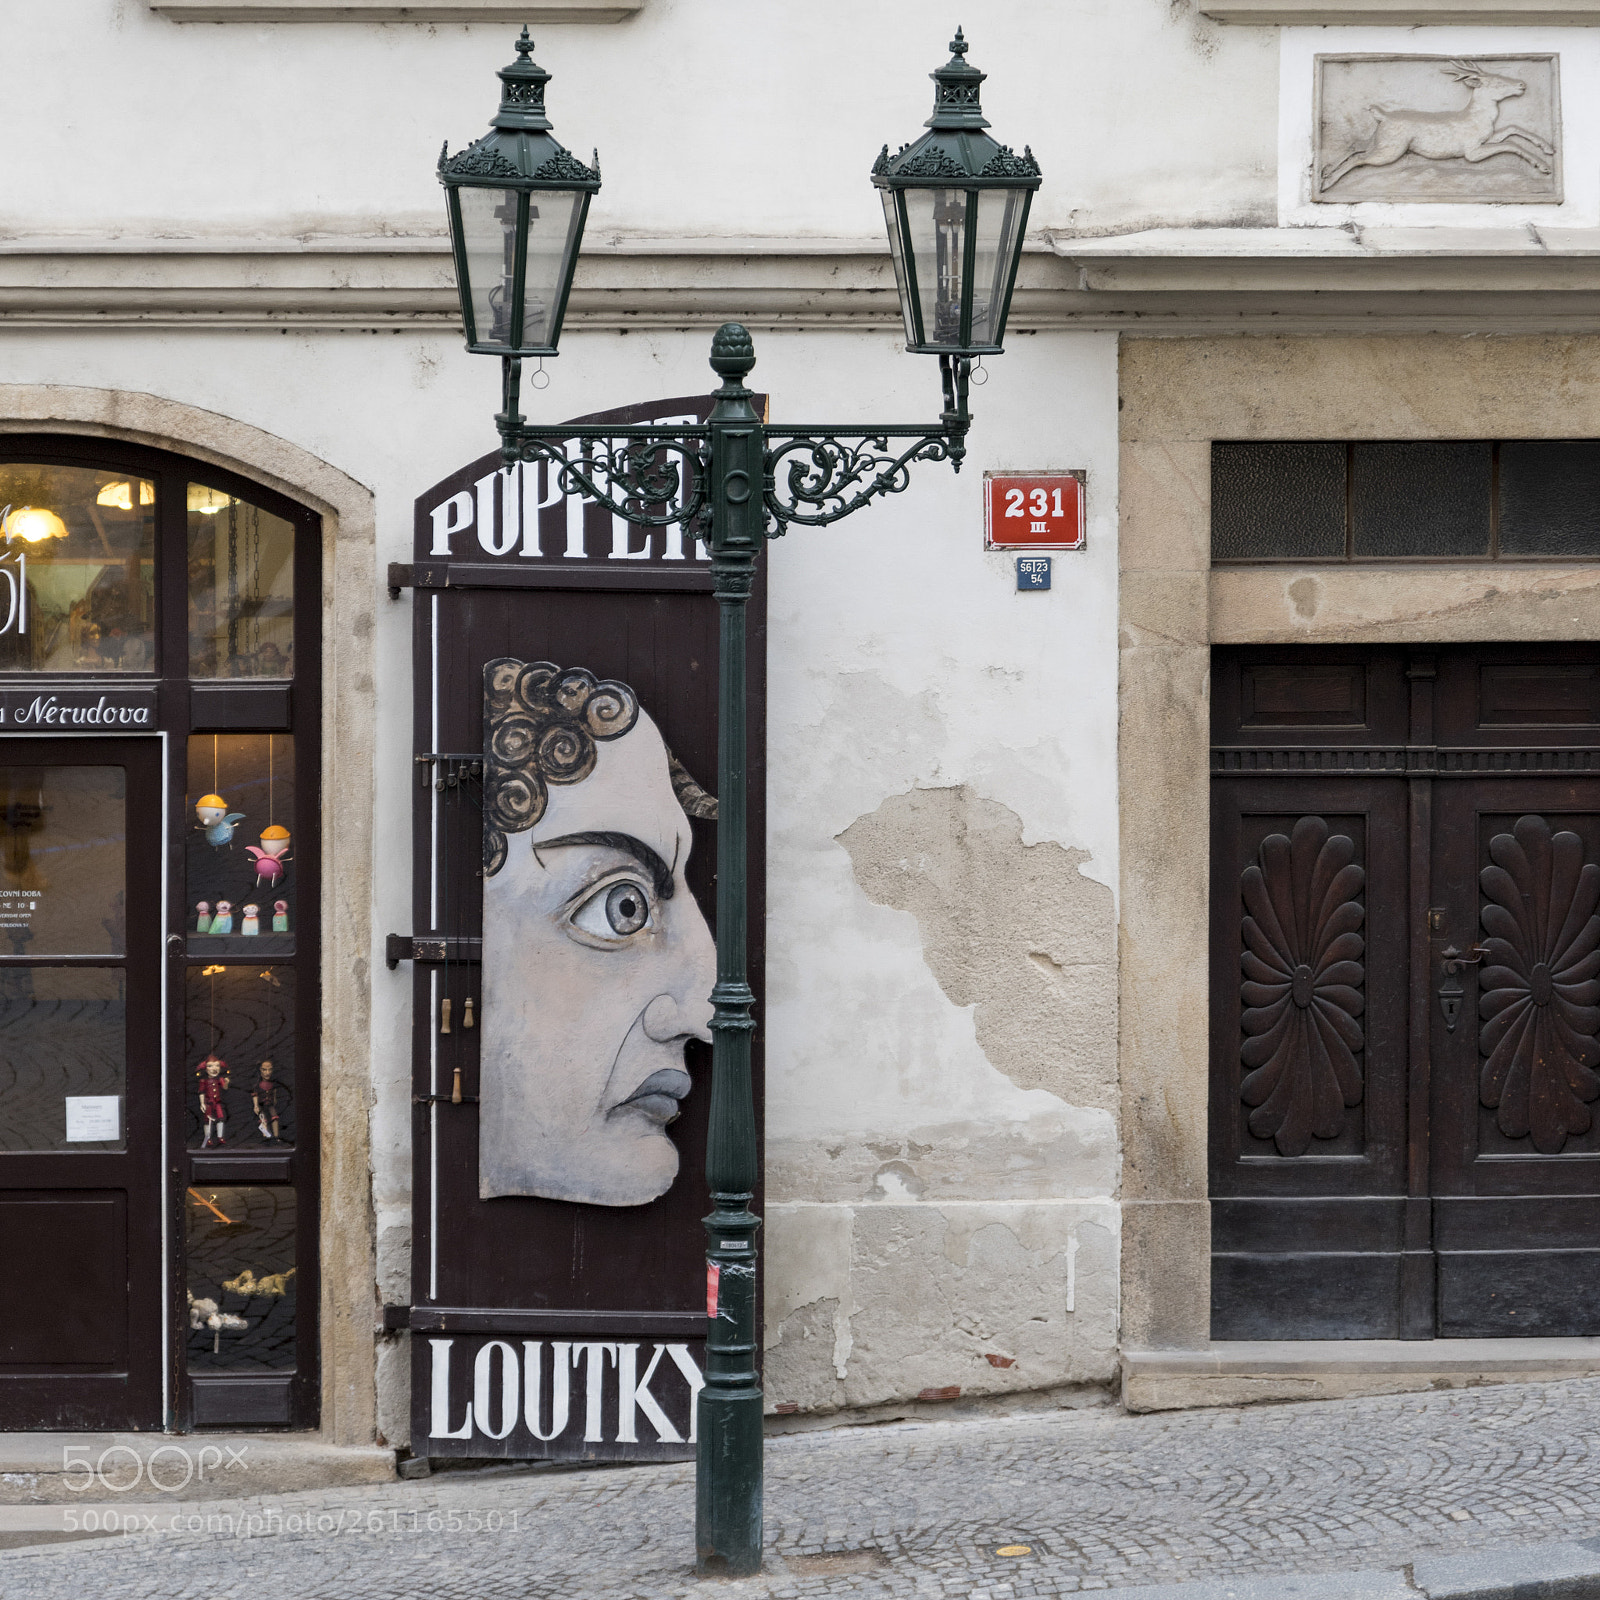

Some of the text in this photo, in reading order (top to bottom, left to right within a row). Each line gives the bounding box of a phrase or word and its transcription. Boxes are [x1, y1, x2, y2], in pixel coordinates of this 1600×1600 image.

[430, 414, 712, 560] PUPPET
[1005, 488, 1064, 517] 231
[1030, 522, 1050, 533] III.
[1031, 574, 1042, 583] 54
[14, 696, 148, 723] Nerudova
[21, 890, 41, 898] DOBA
